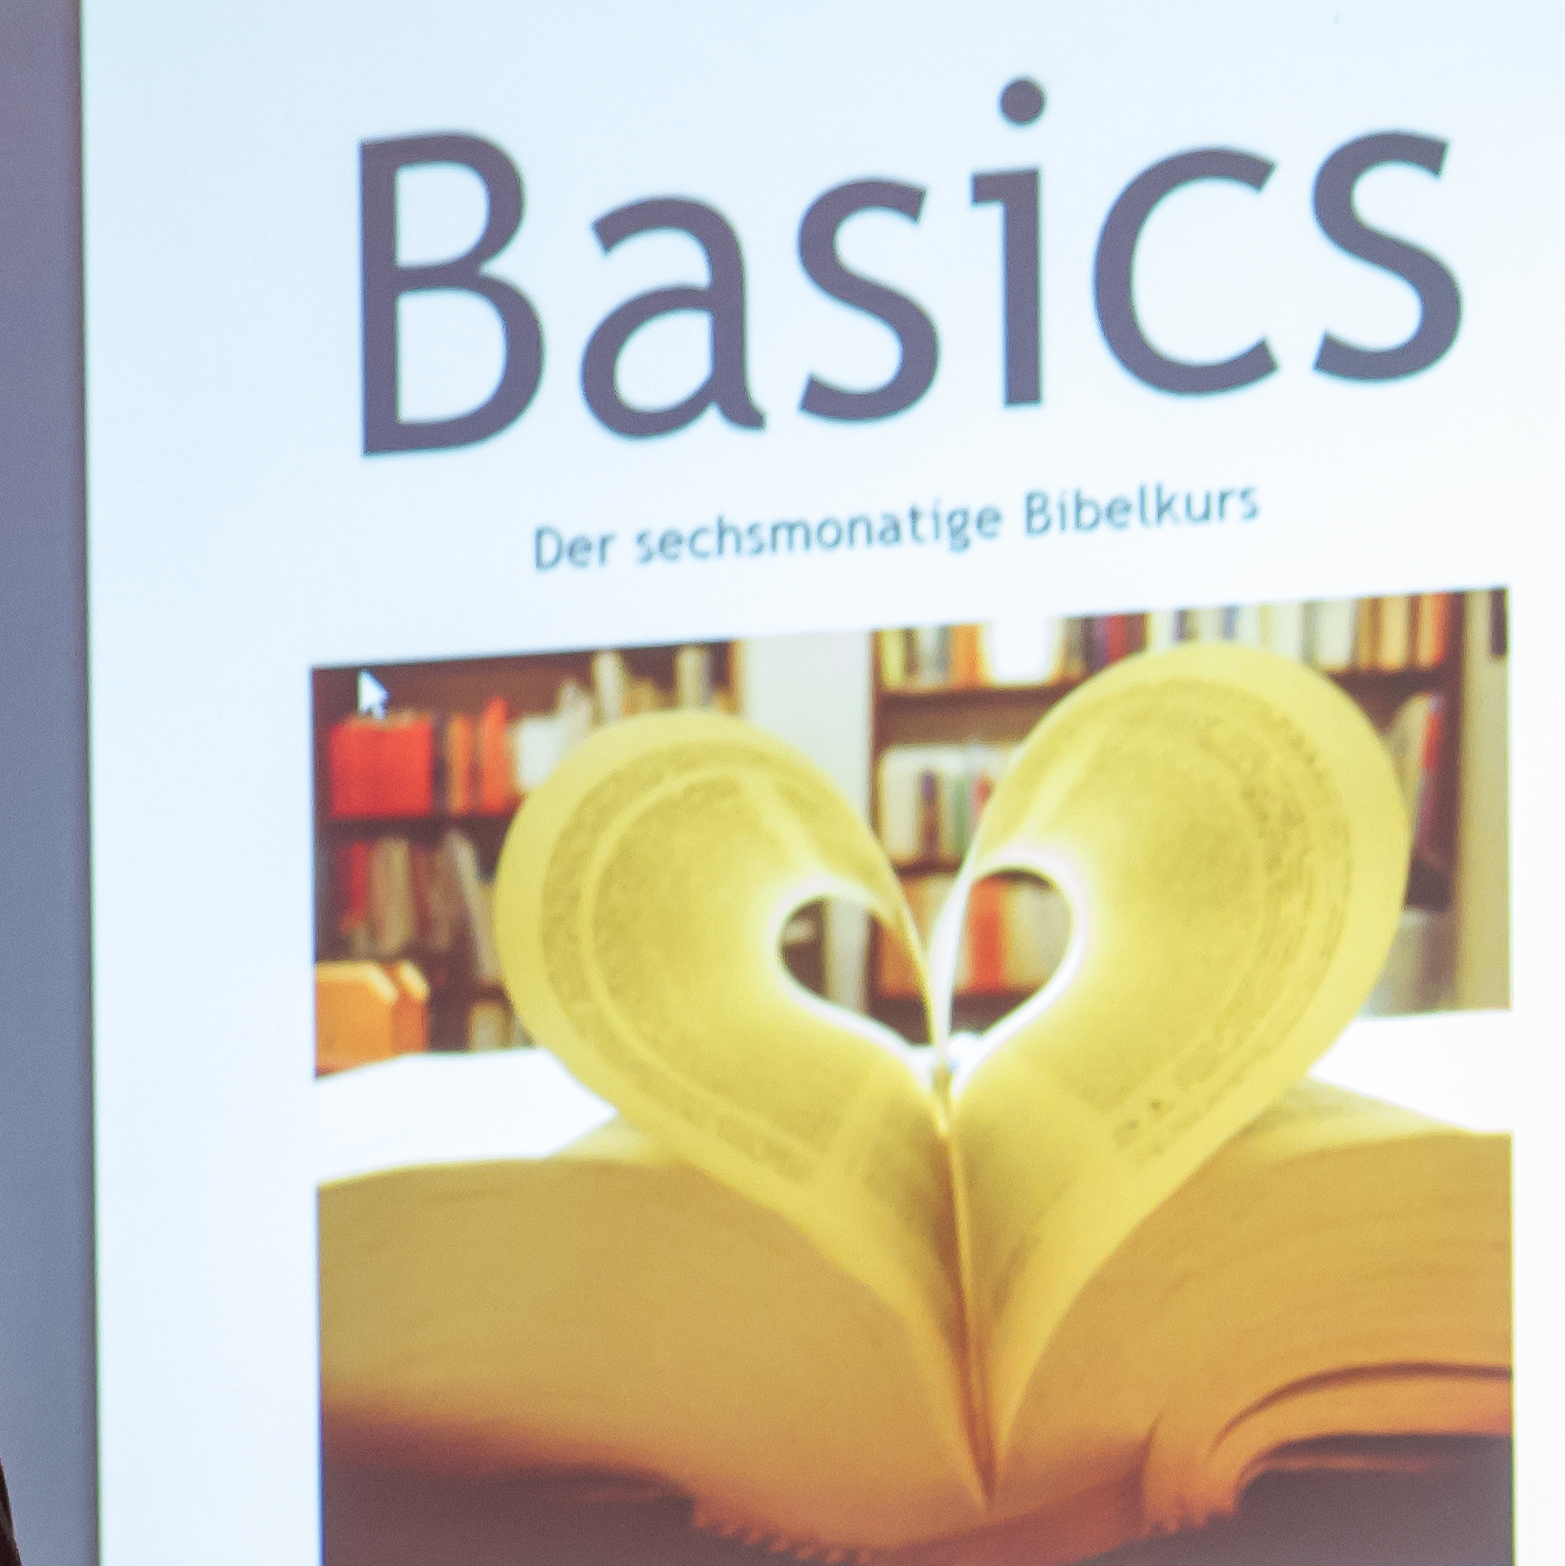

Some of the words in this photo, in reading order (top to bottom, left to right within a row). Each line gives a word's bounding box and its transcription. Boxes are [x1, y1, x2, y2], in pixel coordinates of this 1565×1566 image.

[358, 74, 1466, 459] Basics
[533, 524, 617, 573] Der
[635, 497, 1003, 563] sechsmonatige
[1024, 481, 1260, 537] Bibelkurs
